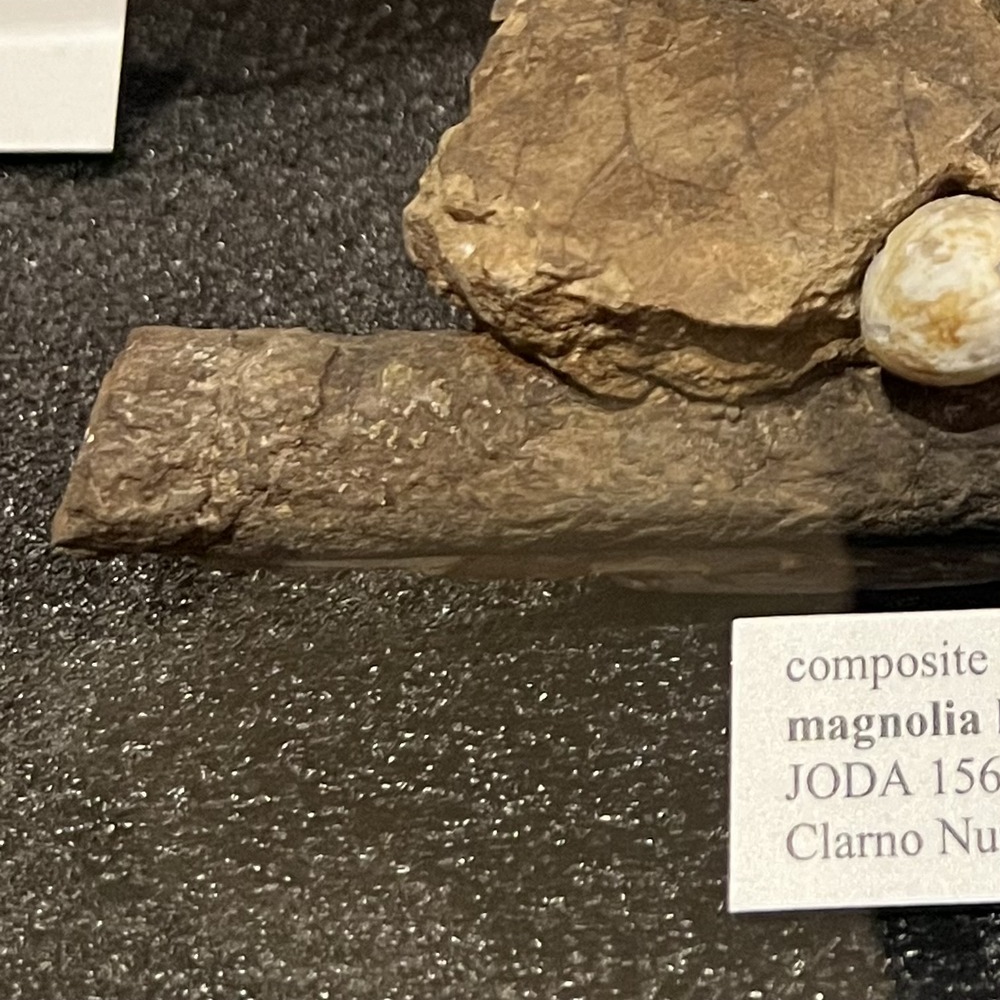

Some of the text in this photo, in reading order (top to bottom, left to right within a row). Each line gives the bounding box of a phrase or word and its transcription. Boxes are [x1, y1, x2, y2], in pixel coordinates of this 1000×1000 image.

[787, 640, 988, 690] composite
[788, 700, 981, 750] magnolia
[785, 760, 913, 801] JODA
[786, 822, 923, 860] Clarno
